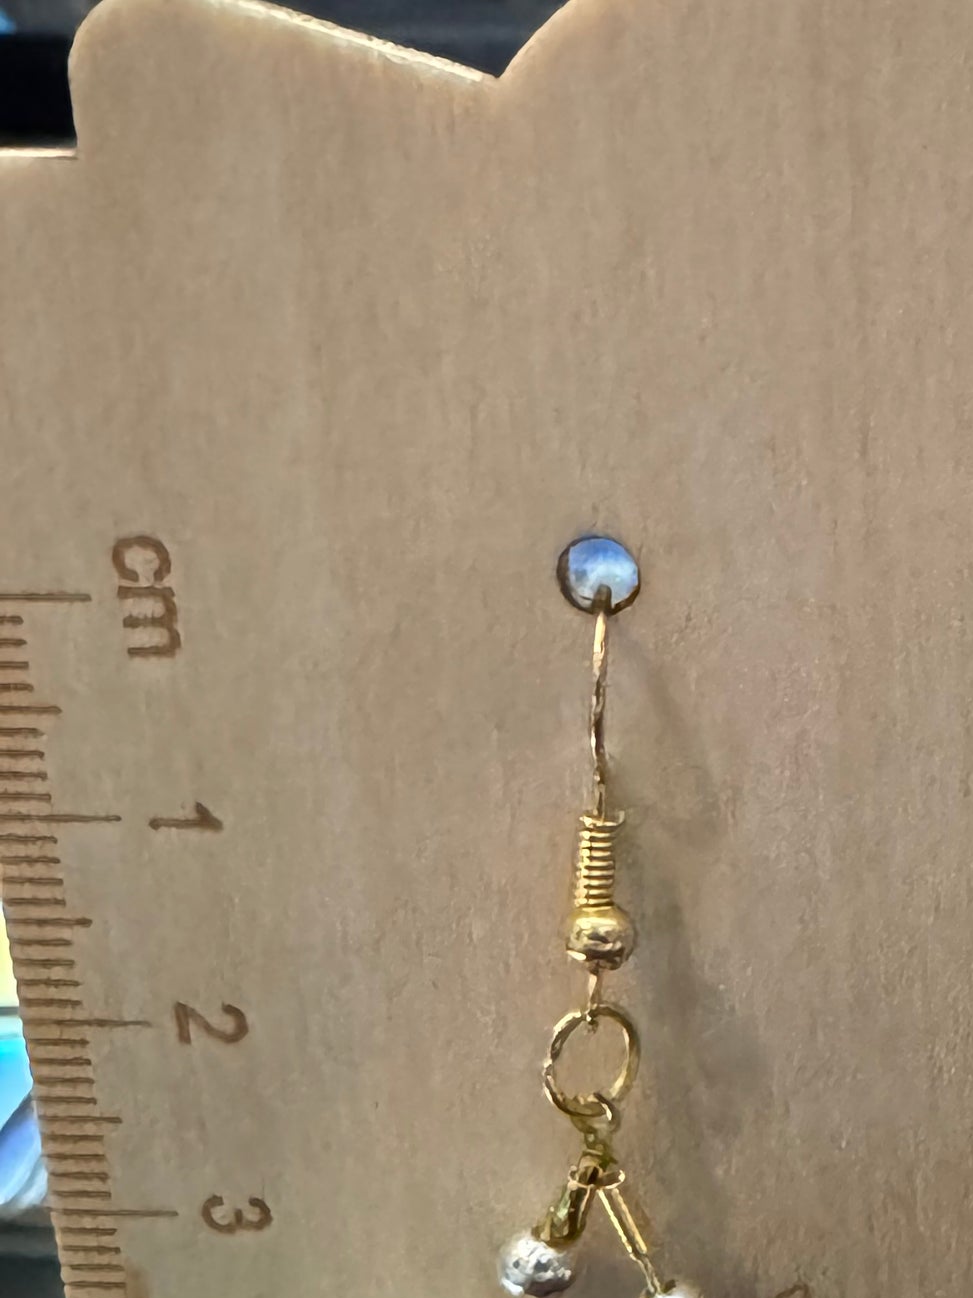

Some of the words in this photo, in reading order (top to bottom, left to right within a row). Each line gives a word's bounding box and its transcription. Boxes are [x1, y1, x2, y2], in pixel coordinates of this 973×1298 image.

[111, 534, 182, 659] cm
[148, 801, 224, 833] 1
[173, 1001, 249, 1045] 2
[201, 1194, 273, 1235] 3
